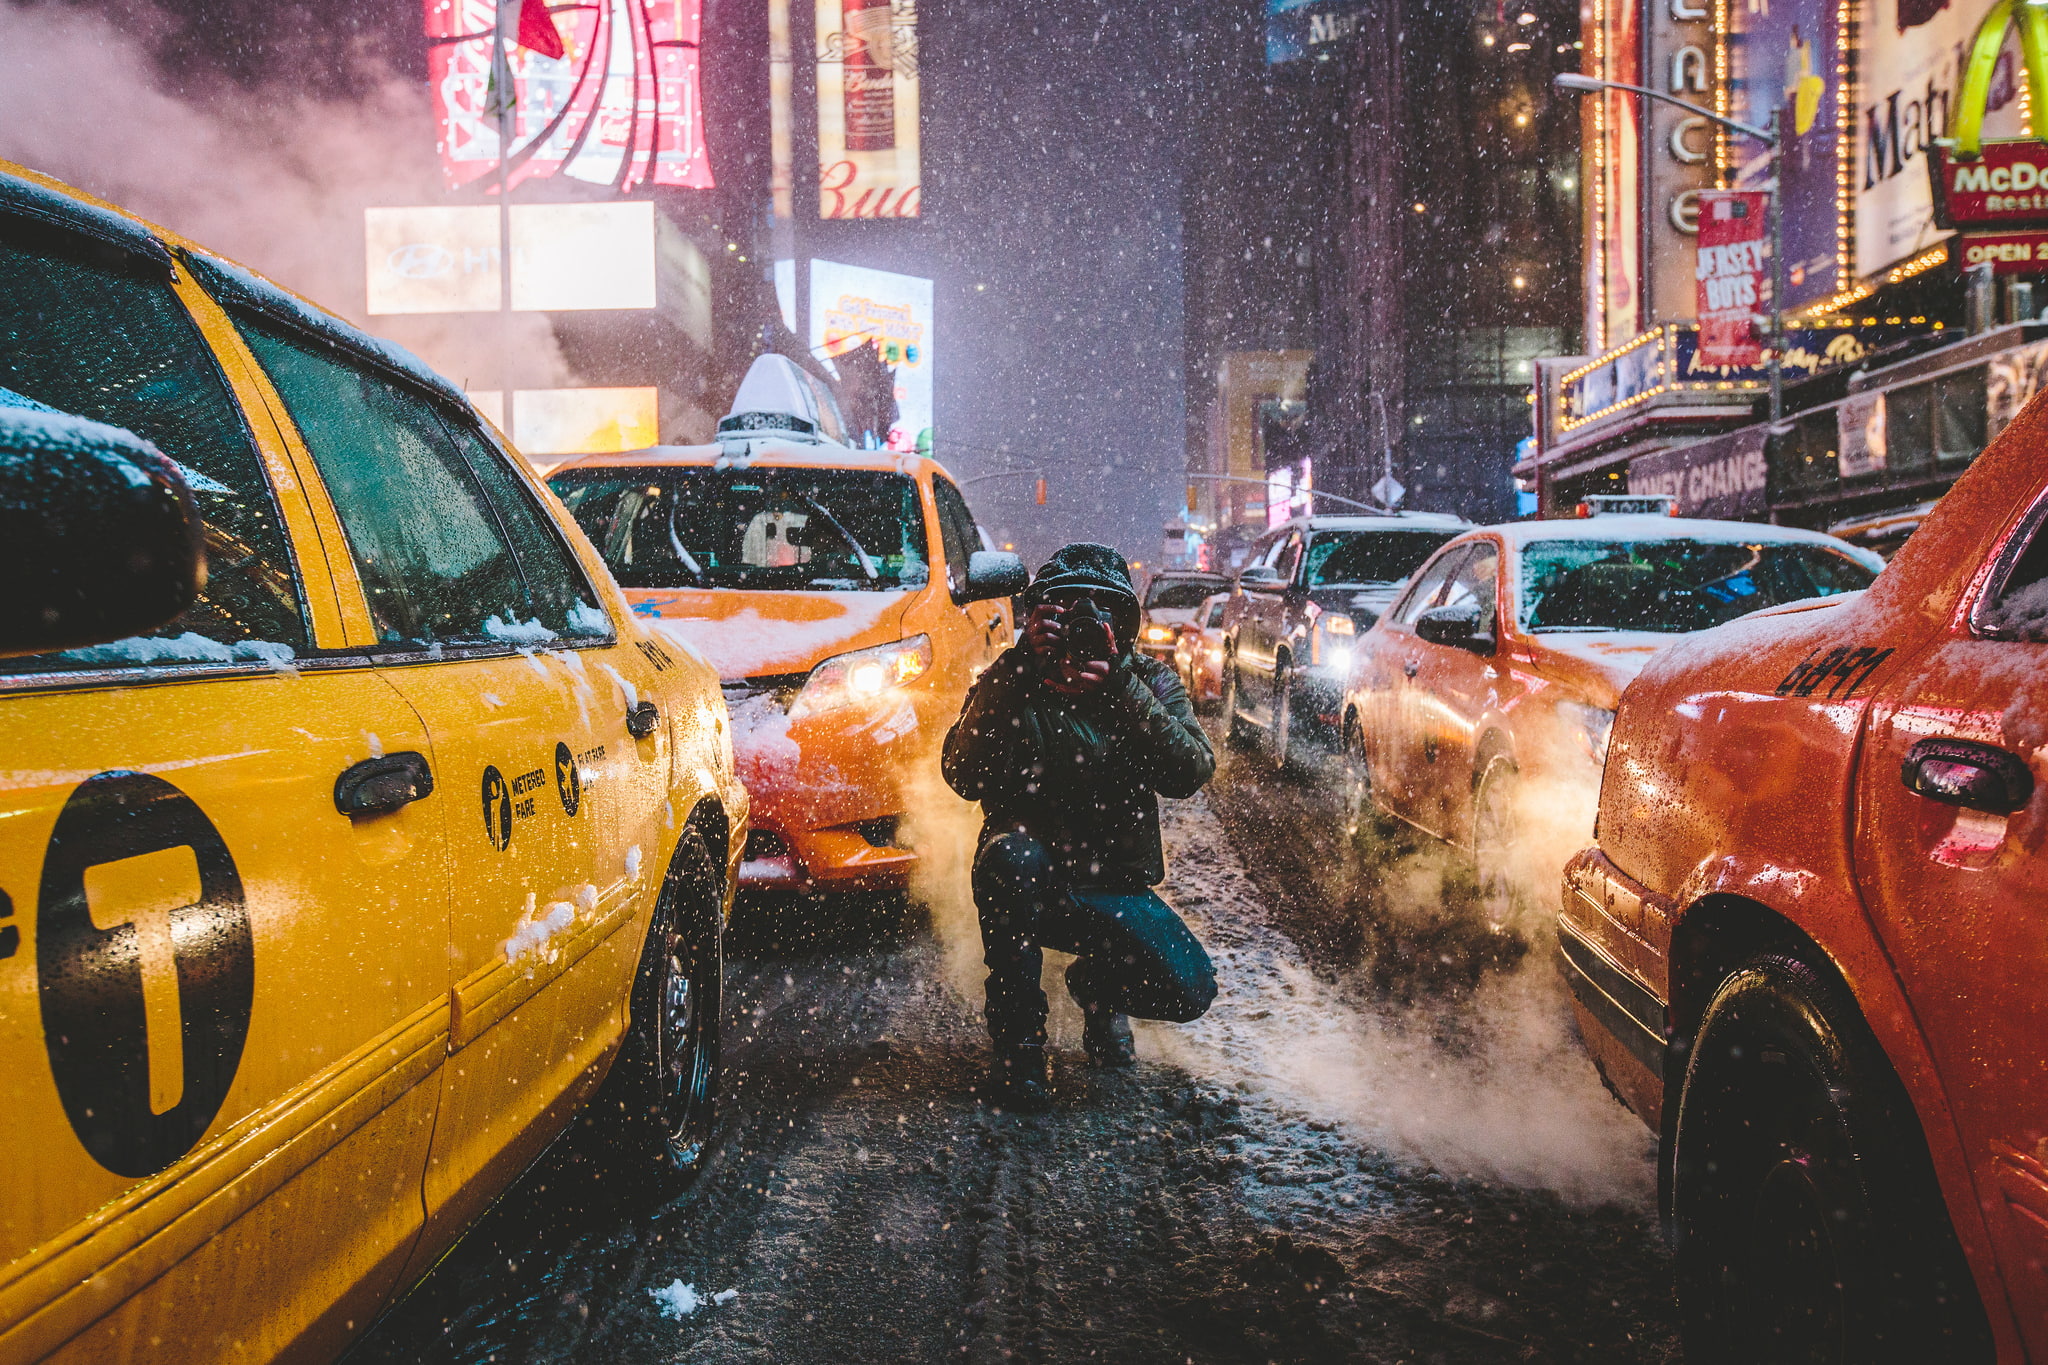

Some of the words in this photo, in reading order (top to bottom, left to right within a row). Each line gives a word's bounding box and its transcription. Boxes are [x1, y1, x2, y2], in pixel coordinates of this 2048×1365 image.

[1986, 194, 2048, 213] Rest
[1696, 240, 1763, 280] JERSEY
[1966, 243, 2031, 263] OPEN
[1706, 274, 1757, 311] BOYS
[511, 768, 546, 797] METERED
[515, 797, 536, 820] FARE
